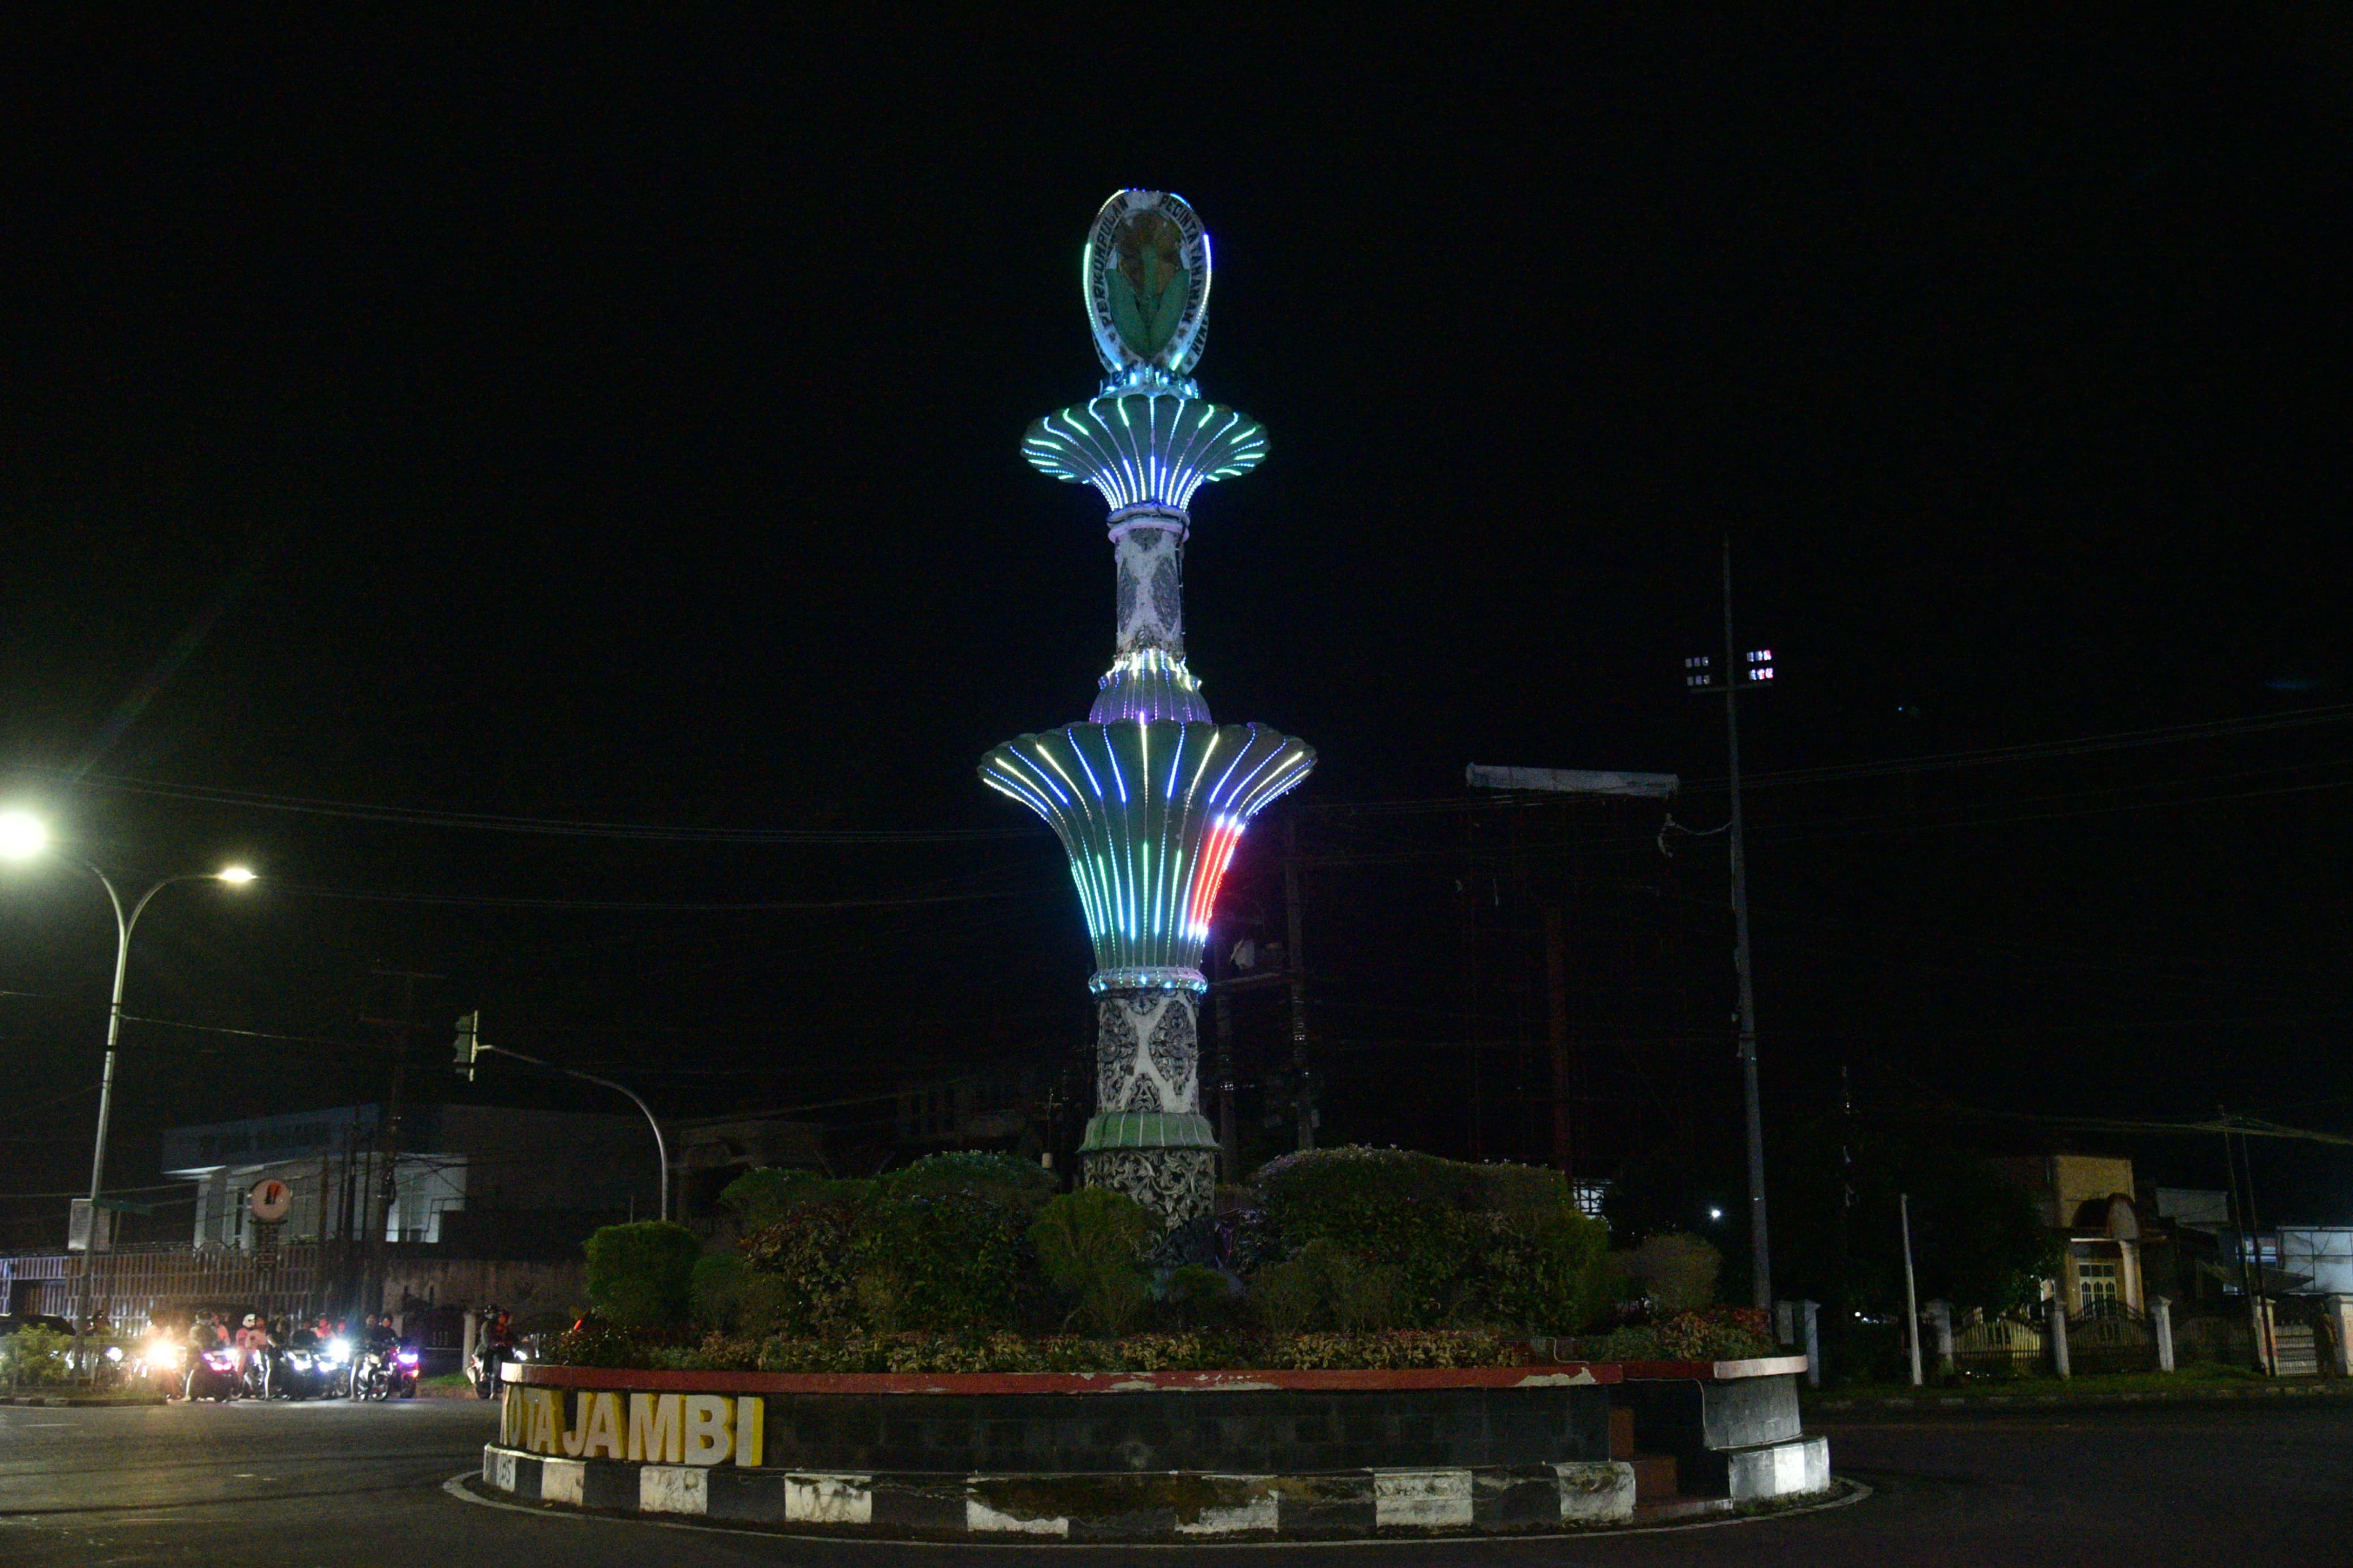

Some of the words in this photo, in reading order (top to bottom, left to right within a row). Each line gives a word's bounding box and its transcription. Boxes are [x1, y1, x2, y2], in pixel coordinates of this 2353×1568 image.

[1093, 196, 1128, 328] PERKUMPULAN
[1159, 195, 1199, 244] PECINTA
[562, 1390, 764, 1467] JAMBI
